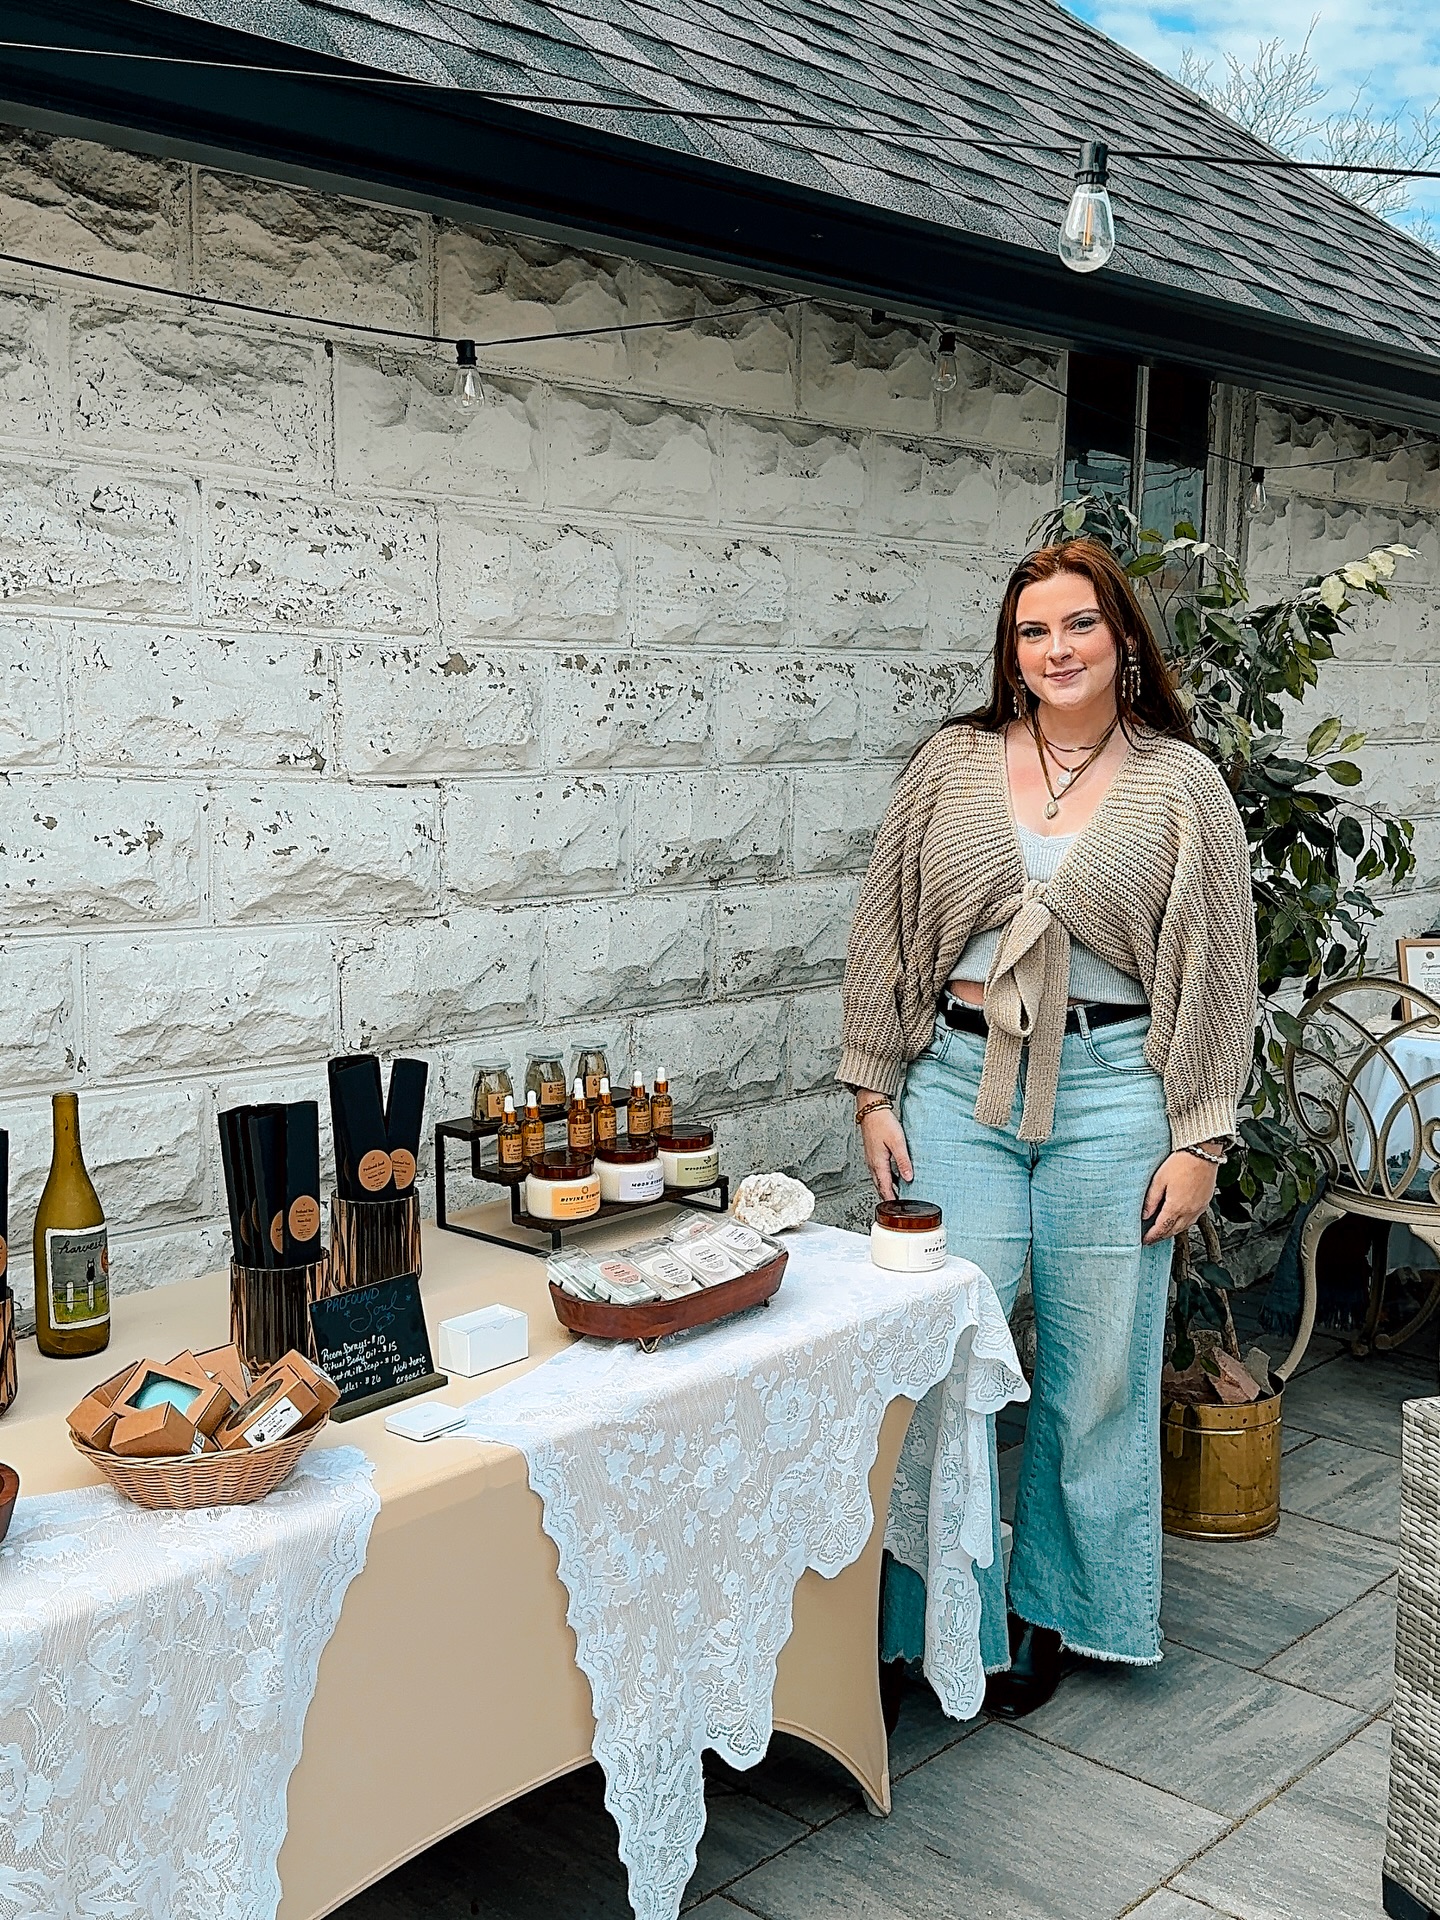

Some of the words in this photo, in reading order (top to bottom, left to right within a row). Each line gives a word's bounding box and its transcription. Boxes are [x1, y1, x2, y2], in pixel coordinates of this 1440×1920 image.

[57, 1236, 103, 1254] harvest
[324, 1287, 380, 1313] PROFOUND
[349, 1290, 406, 1333] Soul
[321, 1348, 343, 1363] Room
[322, 1358, 346, 1372] Ritual
[365, 1347, 377, 1360] Oil
